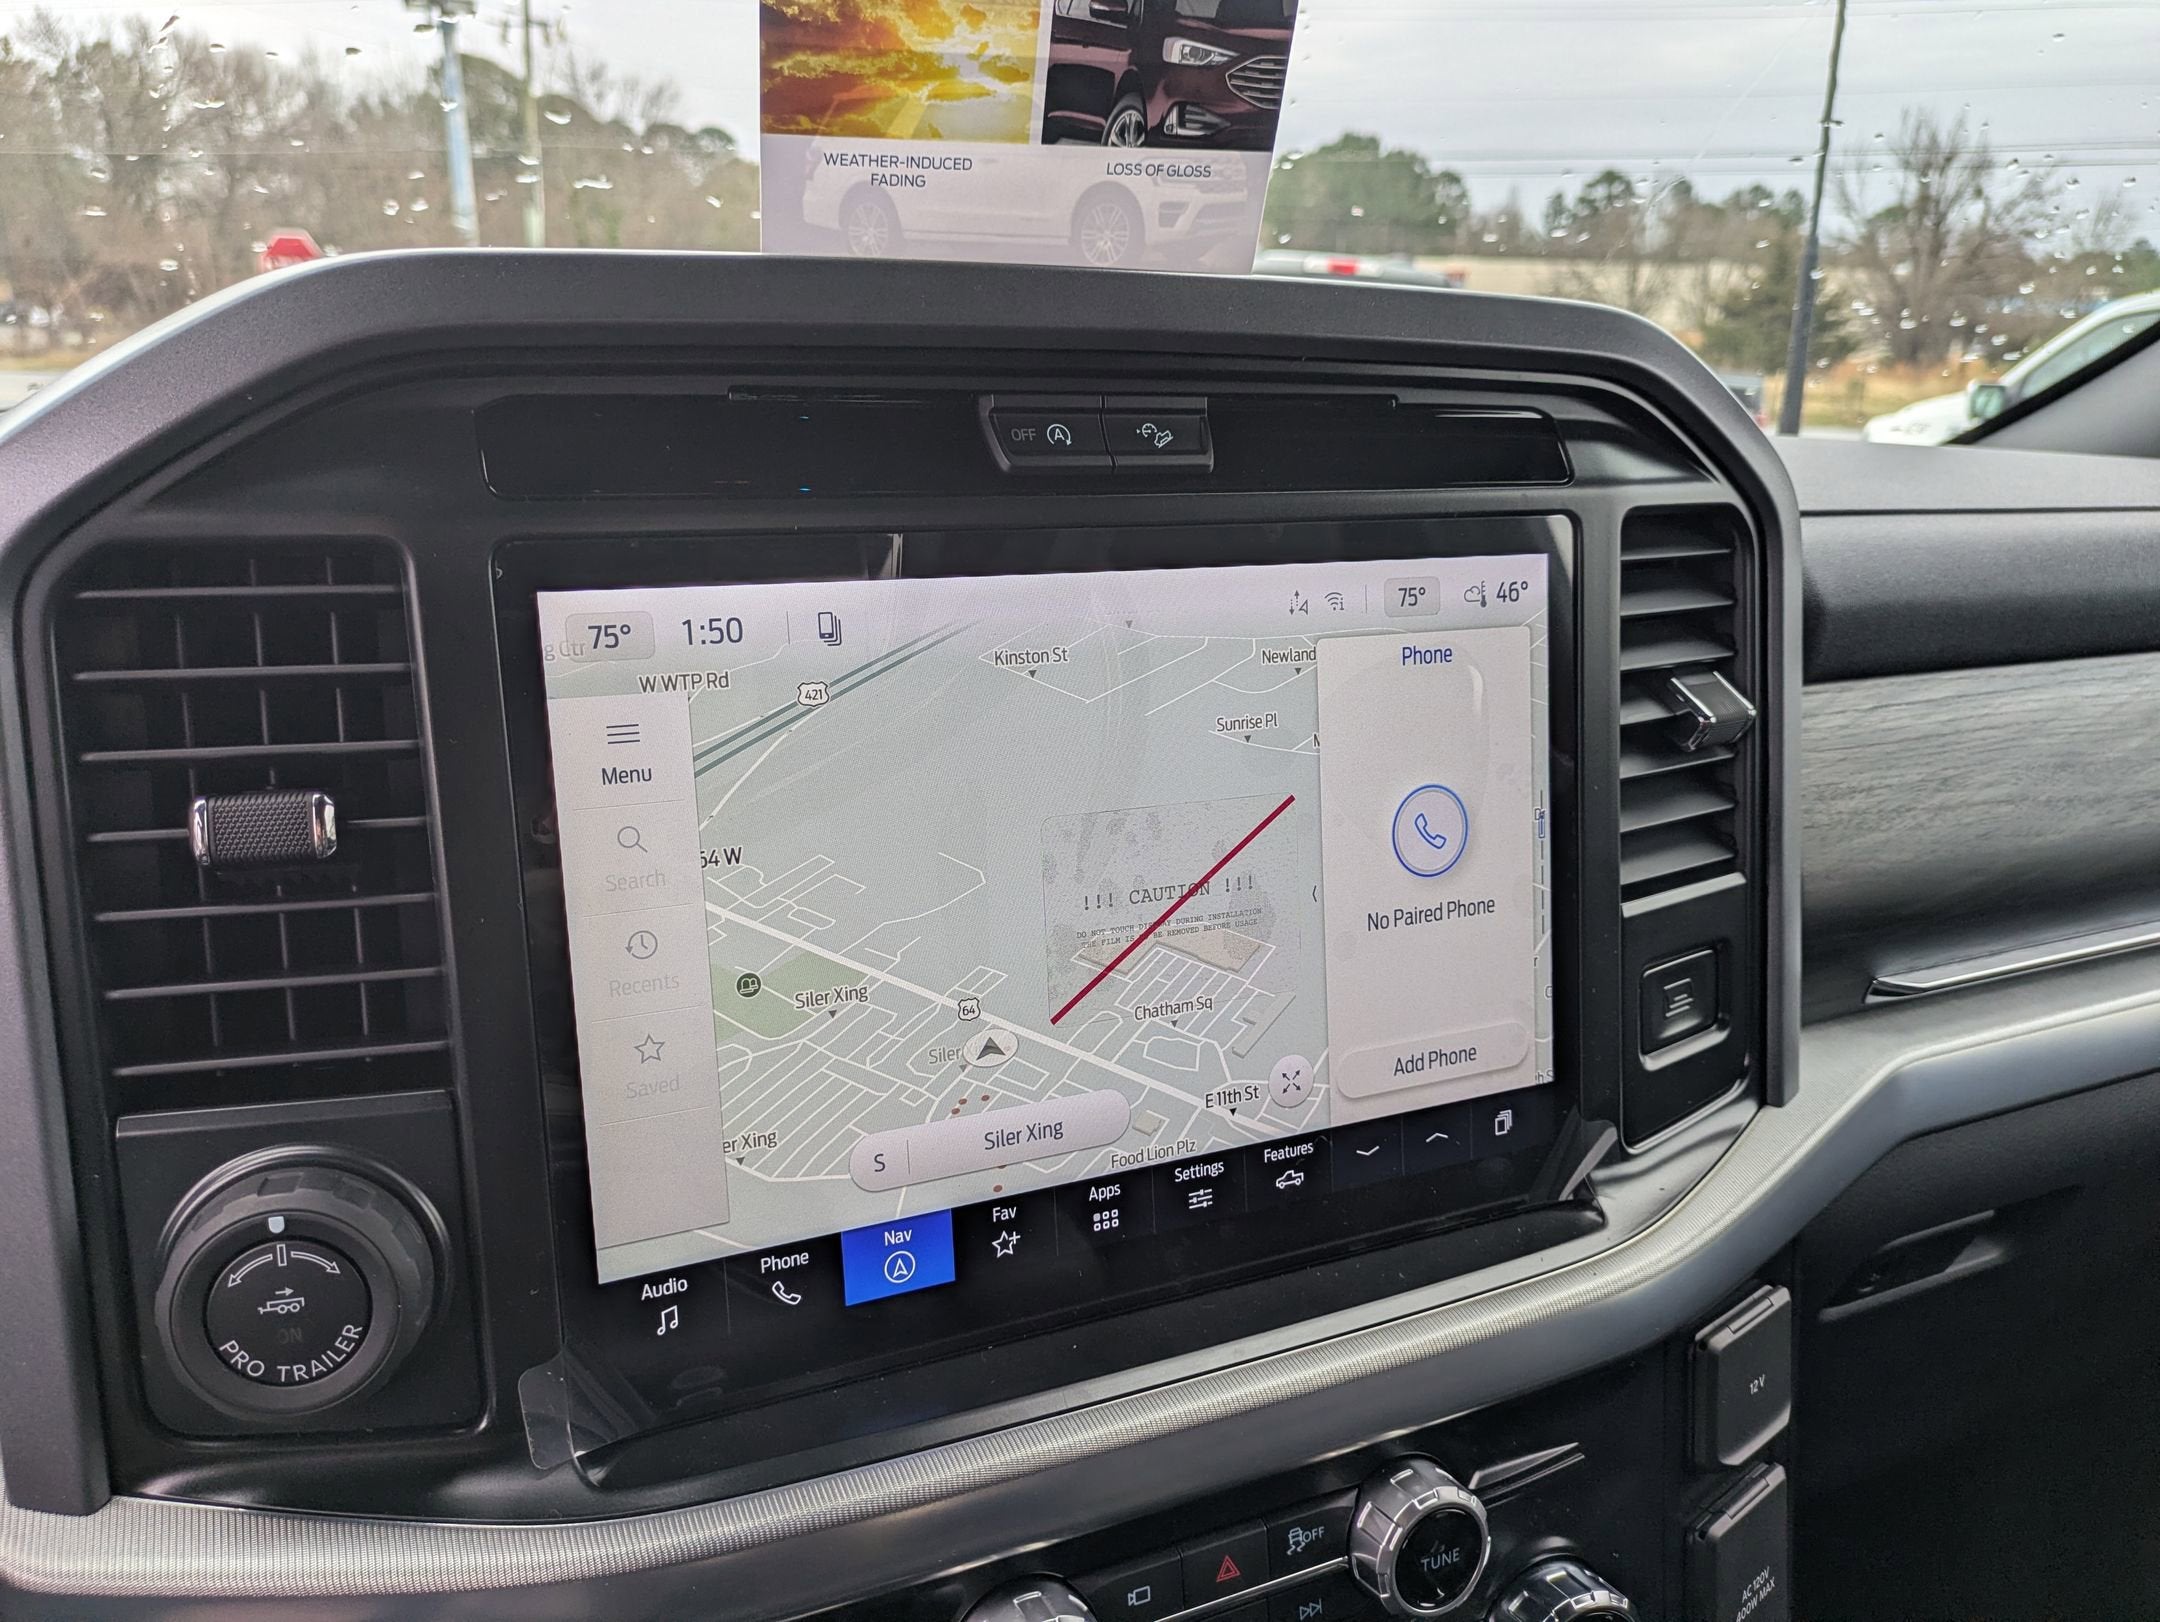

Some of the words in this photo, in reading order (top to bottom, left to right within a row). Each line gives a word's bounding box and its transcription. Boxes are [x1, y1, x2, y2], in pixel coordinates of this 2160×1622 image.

[823, 151, 973, 172] WEATHER-INDUCED
[1106, 162, 1142, 177] LOSS
[1144, 163, 1164, 177] OF
[1166, 163, 1212, 178] GLOSS
[870, 173, 927, 189] FADING
[1011, 428, 1036, 442] OFF
[1398, 586, 1426, 608] 75°
[1496, 580, 1529, 603] 46°
[587, 623, 632, 649] 75°
[682, 617, 744, 645] 1:50
[994, 649, 1049, 666] Kinston
[1052, 647, 1068, 663] St
[1262, 647, 1317, 664] Newland
[1402, 646, 1453, 666] Phone
[639, 675, 657, 693] W
[660, 673, 703, 691] WTP
[706, 671, 730, 689] Rd
[804, 688, 824, 701] 421
[1216, 715, 1263, 732] Sunrise
[1265, 713, 1278, 728] Pl
[601, 766, 652, 785] Menu
[723, 846, 742, 866] W
[605, 869, 667, 892] Search
[1129, 881, 1211, 905] CAUTION
[1076, 931, 1087, 939] DO
[1091, 929, 1106, 937] NOT
[1110, 924, 1135, 934] TOUCH
[1138, 919, 1171, 931] DISAY
[1176, 915, 1203, 926] DURING
[1208, 908, 1262, 920] INSTALLATION
[1367, 912, 1390, 931] No
[1394, 901, 1443, 928] Paired
[1447, 898, 1496, 919] Phone
[1153, 931, 1163, 939] BE
[1167, 927, 1200, 937] REMOVED
[1203, 922, 1231, 932] BEFORE
[1235, 918, 1258, 928] USAGE
[1101, 937, 1120, 946] FILM
[1126, 935, 1135, 943] IS
[609, 974, 680, 998] Recents
[795, 991, 830, 1009] Siler
[834, 985, 868, 1005] Xing
[962, 1004, 976, 1016] 64
[1134, 997, 1194, 1020] Chatham
[1196, 995, 1213, 1012] Sq
[928, 1047, 961, 1064] Siler
[1393, 1054, 1424, 1076] Add
[1428, 1046, 1477, 1069] Phone
[626, 1075, 680, 1099] Saved
[1205, 1093, 1213, 1107] E
[1215, 1088, 1242, 1105] 11th
[1244, 1085, 1260, 1101] St
[741, 1131, 777, 1151] Xing
[984, 1127, 1022, 1150] Siler
[1026, 1120, 1064, 1142] Xing
[873, 1153, 886, 1172] S
[1111, 1151, 1145, 1169] Food
[1147, 1144, 1173, 1162] Lion
[1176, 1139, 1196, 1157] Plz
[1263, 1142, 1314, 1163] Features
[1174, 1160, 1225, 1183] Settings
[1089, 1183, 1121, 1202] Apps
[992, 1206, 1017, 1222] Fav
[884, 1228, 913, 1246] Nav
[760, 1251, 809, 1274] Phone
[641, 1277, 688, 1301] Audio
[219, 1340, 265, 1377] PRO
[277, 1324, 363, 1382] TRAILER
[1750, 1374, 1765, 1395] 12V
[1303, 1526, 1325, 1544] OFF
[1420, 1547, 1460, 1572] TUNE
[1742, 1584, 1752, 1603] AC
[1753, 1566, 1770, 1591] 120V
[1760, 1576, 1775, 1602] MAX
